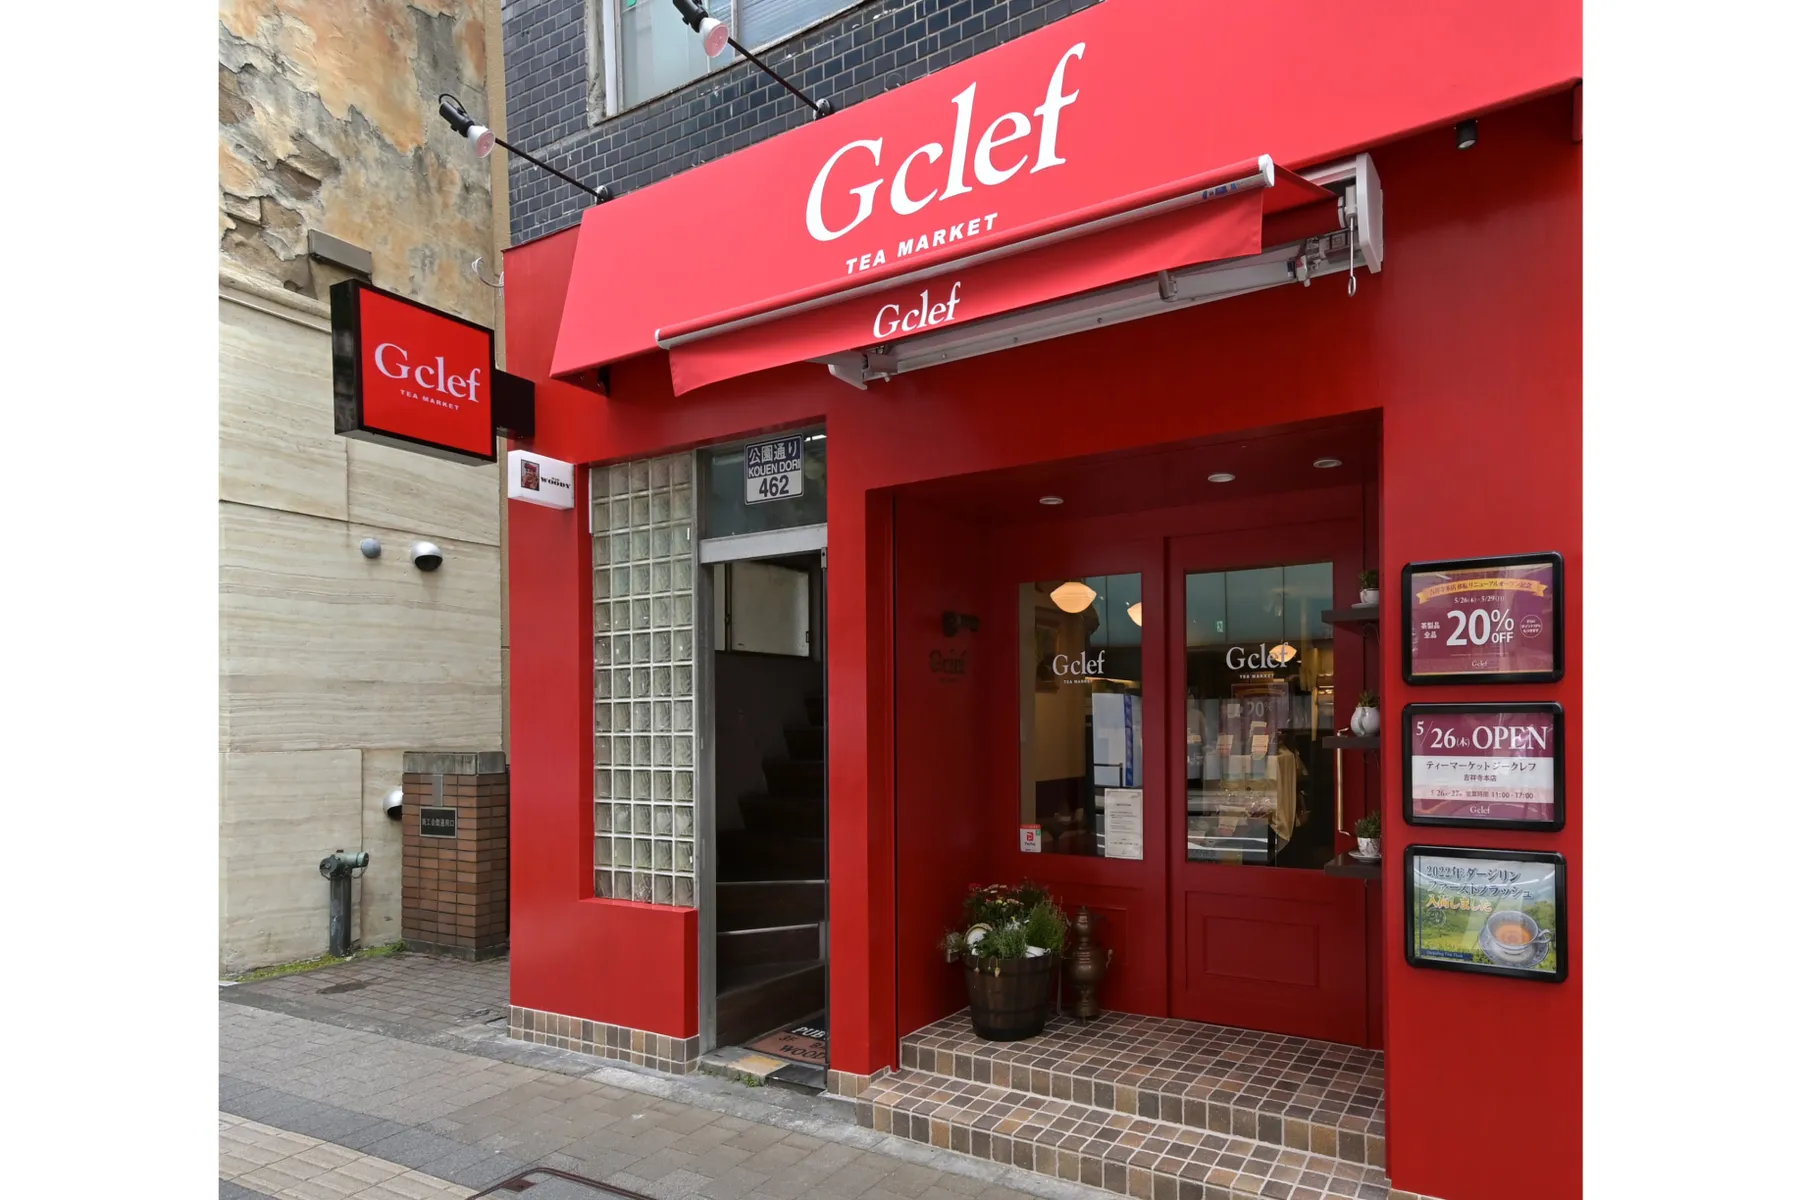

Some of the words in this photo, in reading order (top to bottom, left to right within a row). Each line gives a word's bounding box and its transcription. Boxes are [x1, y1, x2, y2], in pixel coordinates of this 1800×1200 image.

[805, 42, 1086, 242] Gclef
[846, 250, 886, 274] TEA
[897, 212, 998, 258] MARKET
[873, 281, 962, 339] Gclef
[374, 342, 481, 404] Gclef
[400, 388, 419, 400] TEA
[422, 396, 460, 411] MARKET
[748, 443, 799, 465] 公園通り
[748, 462, 778, 479] KOUEN
[779, 459, 801, 475] DORI
[541, 476, 571, 489] WOODY
[759, 475, 790, 498] 462
[1423, 631, 1437, 639] 全品
[1491, 631, 1514, 644] OFF
[1052, 650, 1105, 676] Gclef
[1226, 642, 1288, 670] Gclef
[1472, 725, 1549, 751] OPEN
[1464, 774, 1497, 783] 吉祥寺本店
[1469, 805, 1491, 815] Gclef
[791, 1026, 825, 1038] PUB
